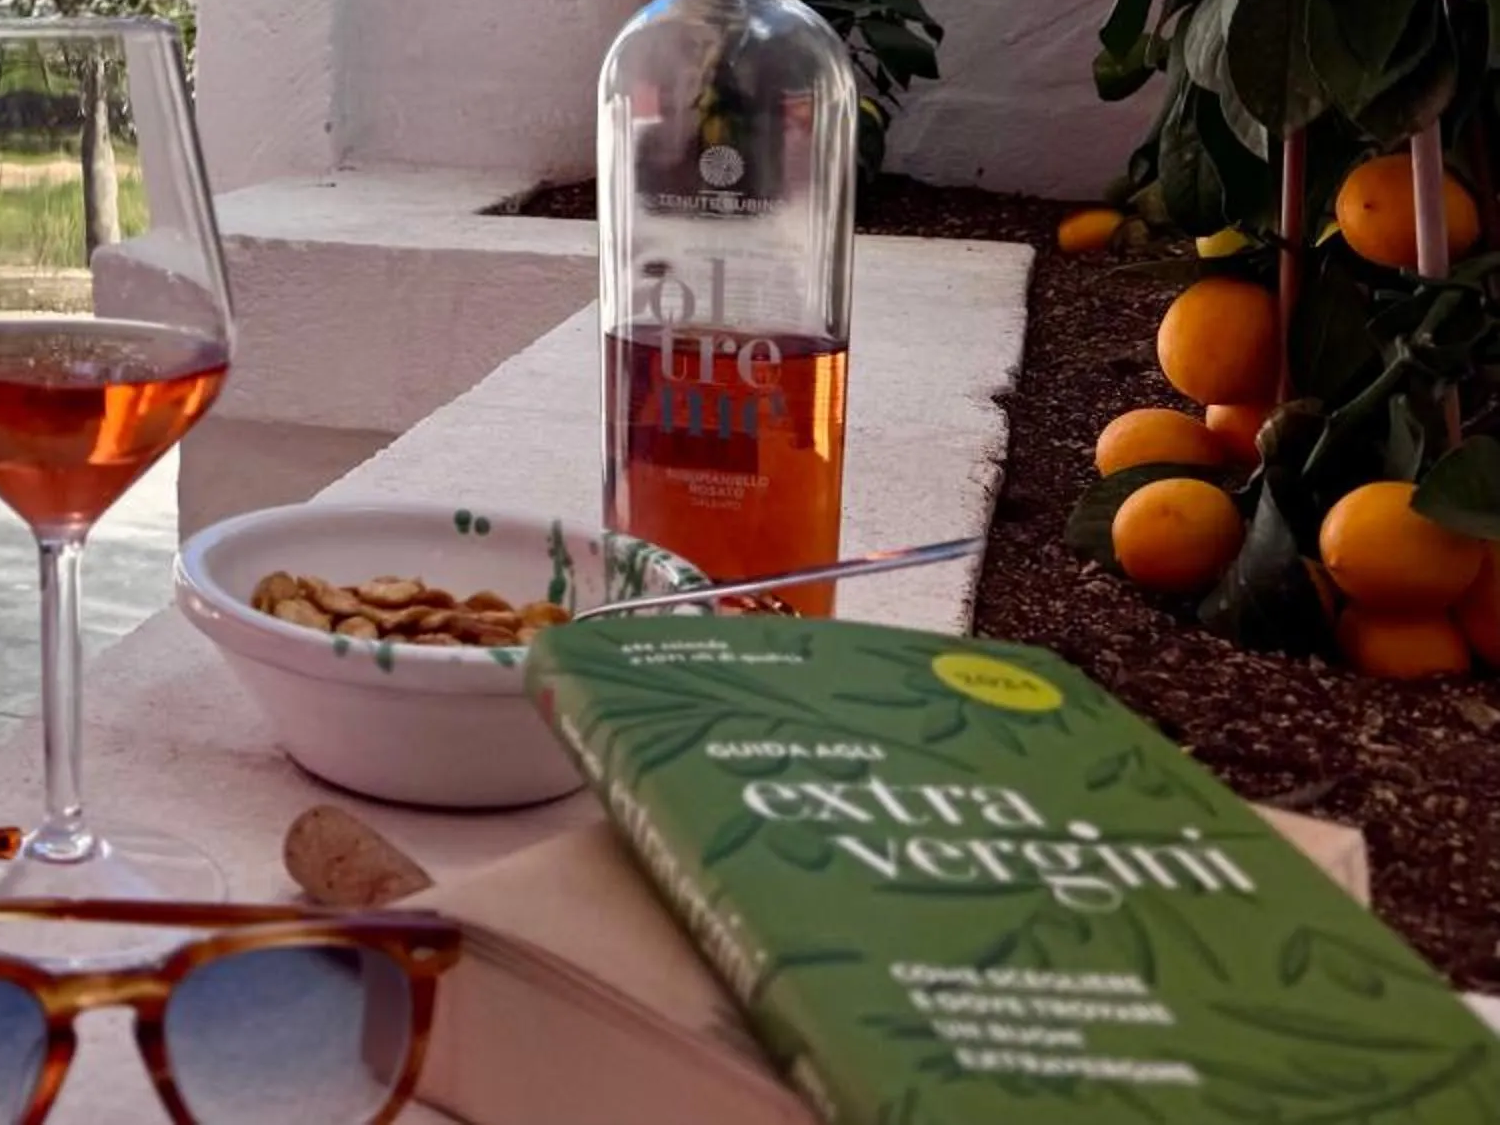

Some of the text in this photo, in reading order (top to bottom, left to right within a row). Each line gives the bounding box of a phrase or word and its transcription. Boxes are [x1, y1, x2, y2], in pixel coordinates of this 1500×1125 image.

[705, 740, 888, 761] GUIDA AGLI
[741, 774, 1047, 827] extra
[829, 820, 1256, 913] vergini
